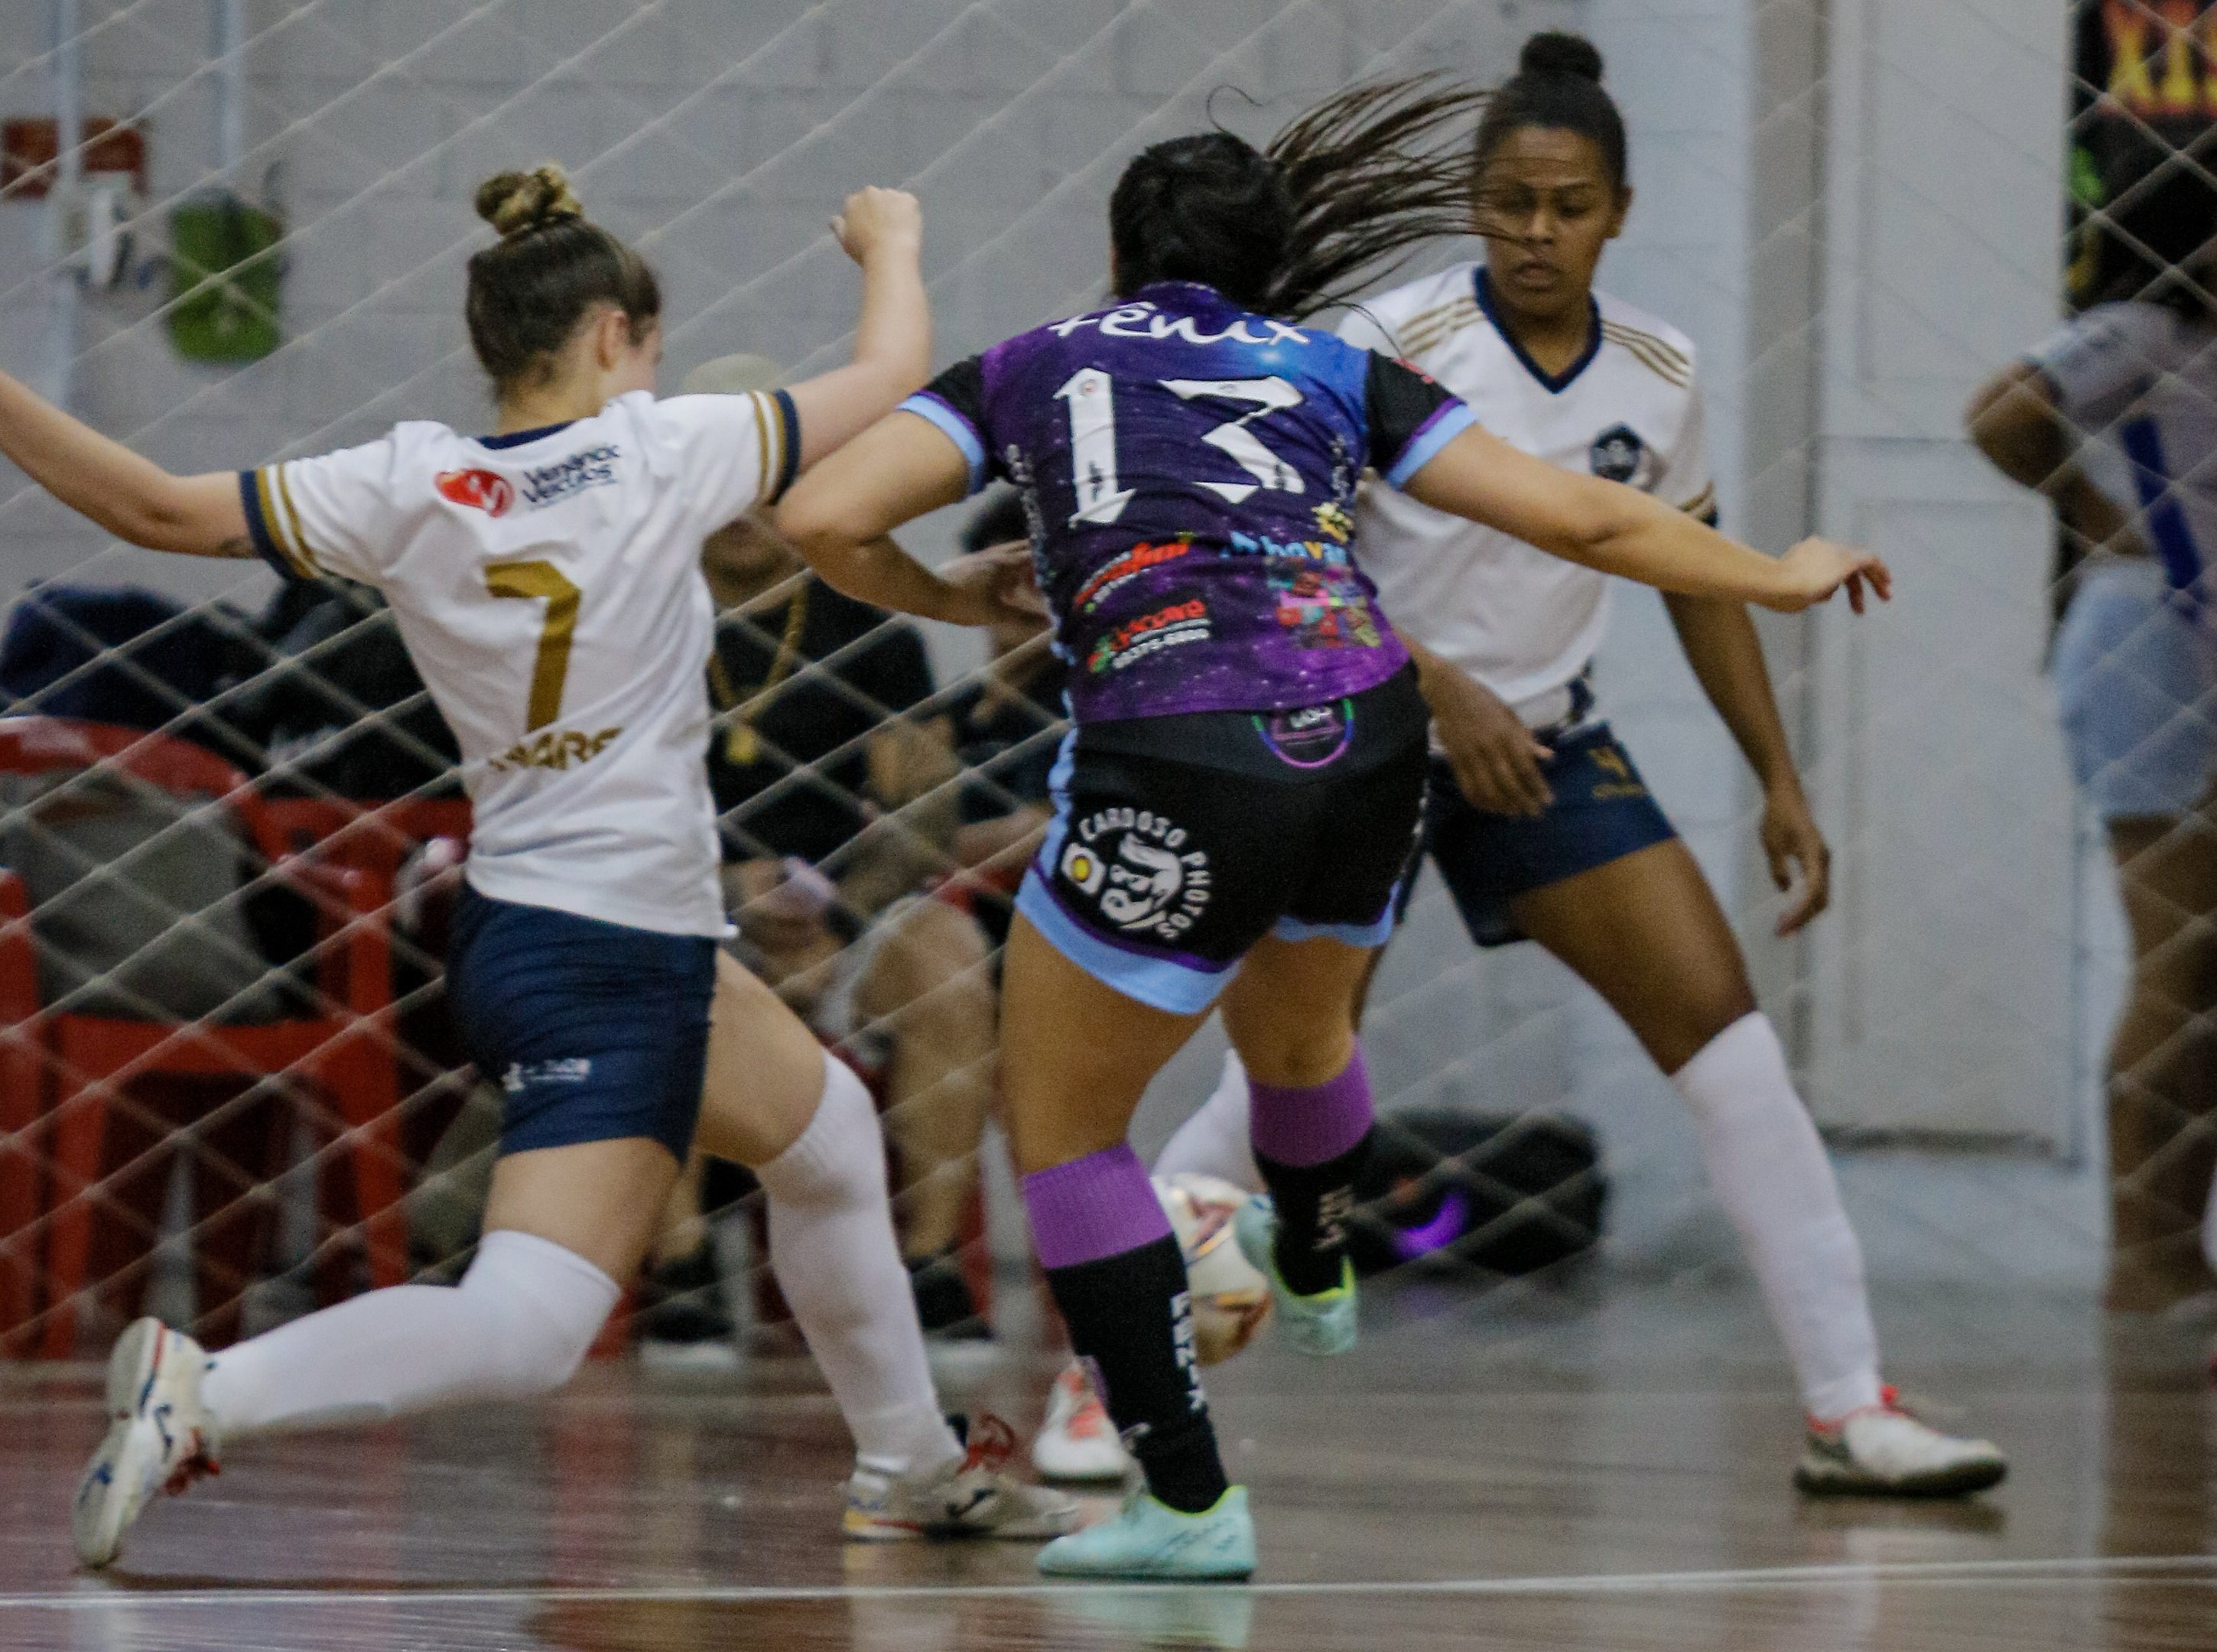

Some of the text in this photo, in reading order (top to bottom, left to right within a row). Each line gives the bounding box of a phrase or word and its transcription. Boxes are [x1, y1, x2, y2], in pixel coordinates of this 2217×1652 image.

[1052, 367, 1305, 528] 13
[483, 559, 580, 733] 7
[1078, 807, 1211, 939] CARDOSO PHOTOS
